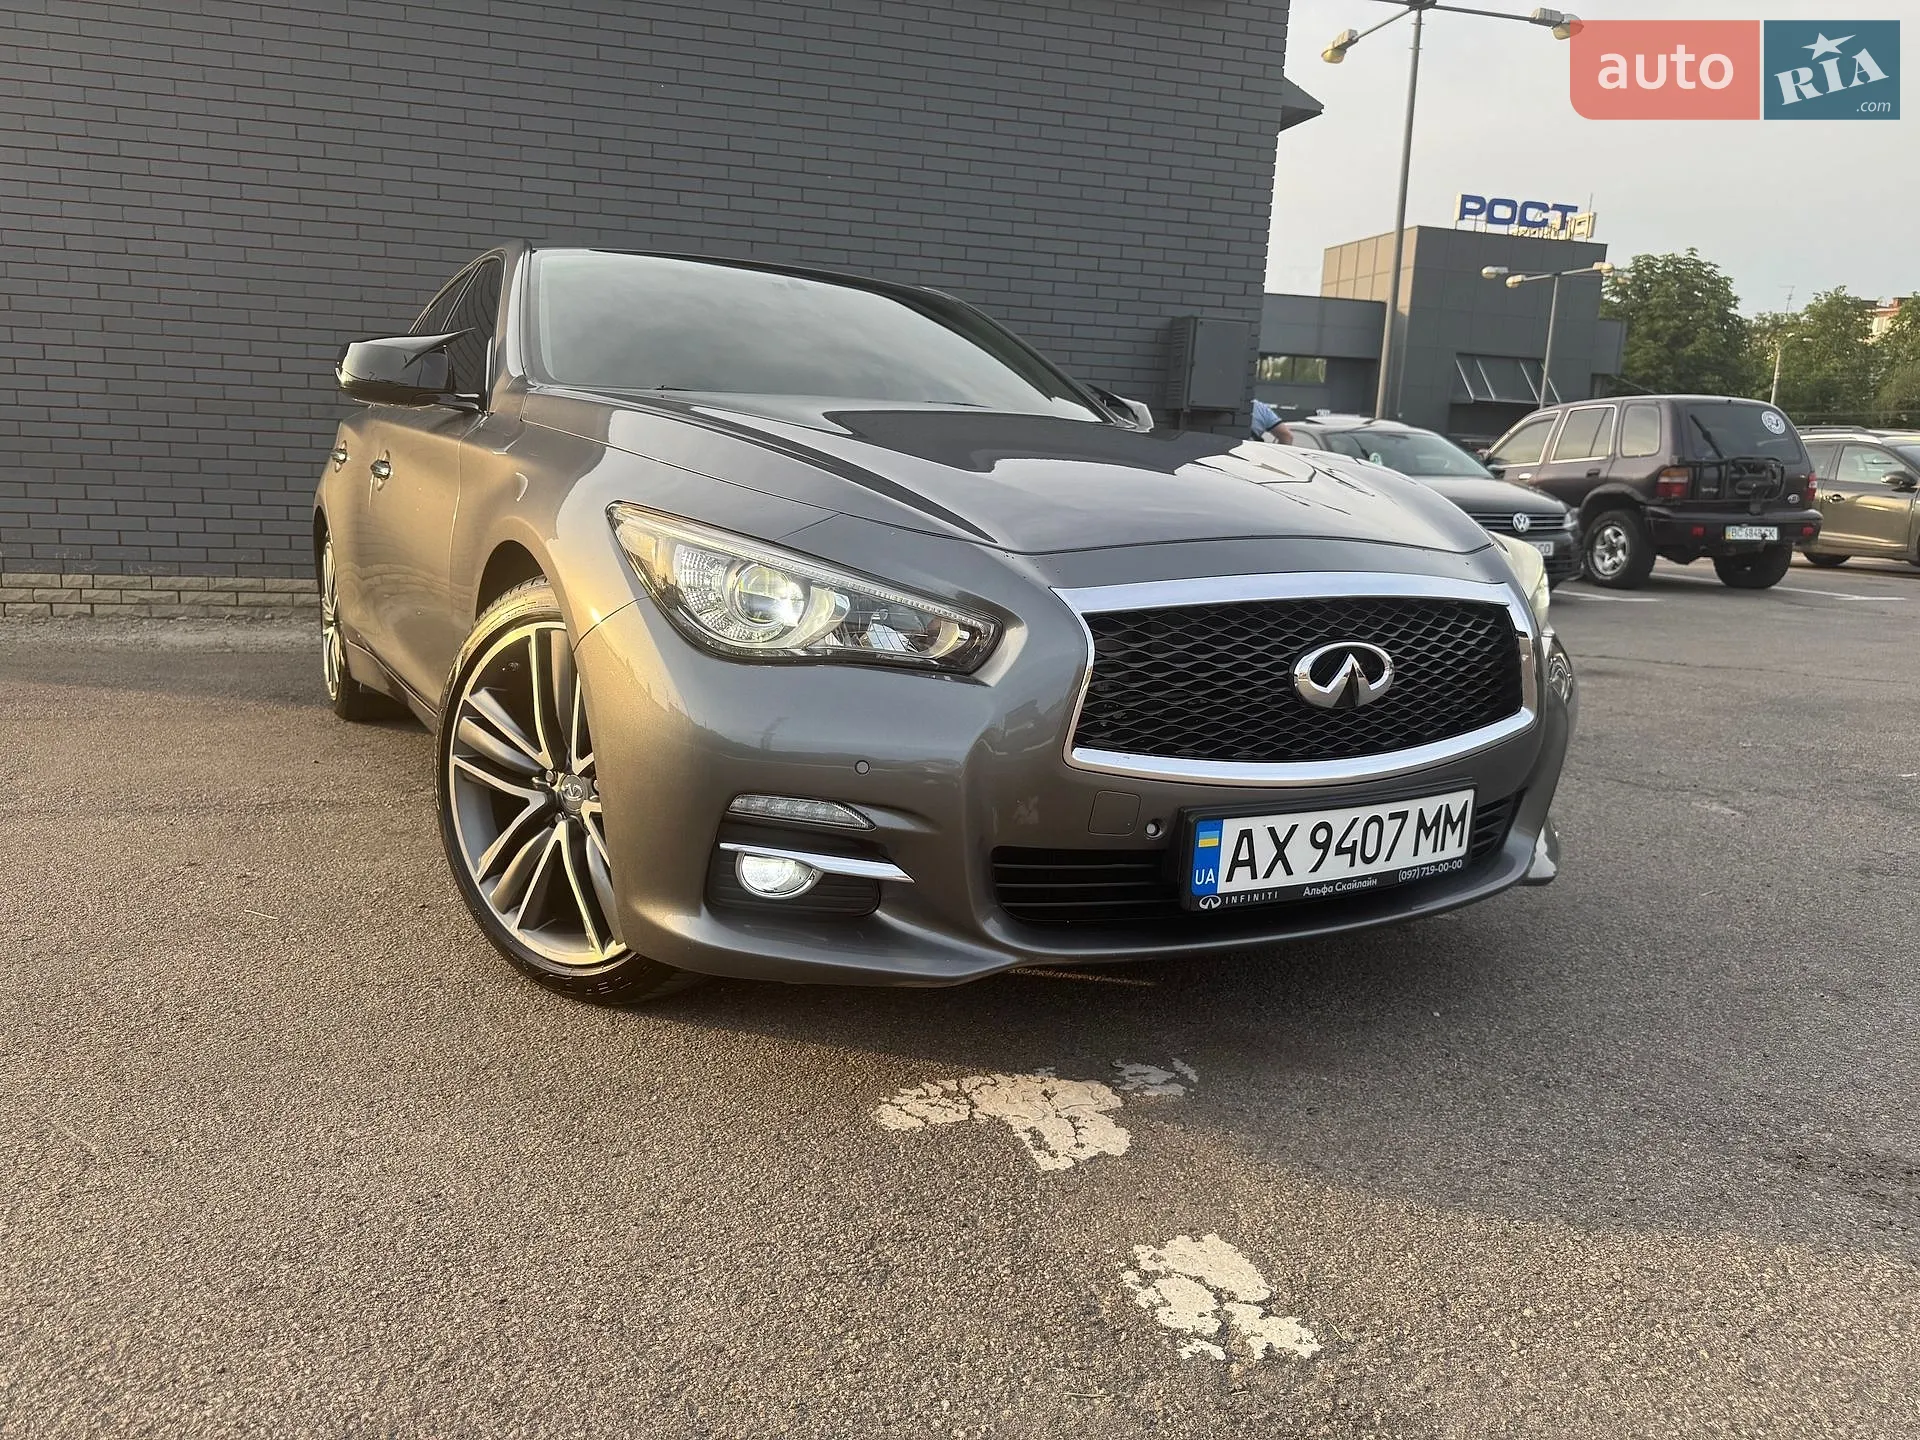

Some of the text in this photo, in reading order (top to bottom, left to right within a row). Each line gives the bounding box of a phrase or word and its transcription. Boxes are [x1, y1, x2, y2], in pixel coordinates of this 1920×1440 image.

[1458, 193, 1578, 230] РОСТ
[1225, 799, 1468, 883] AX 9407 MM
[1195, 868, 1215, 885] UA
[1398, 859, 1463, 883] (097) 719-00-00
[1225, 891, 1278, 905] INFINITI
[1303, 877, 1377, 897] Альфа Скайлайн
